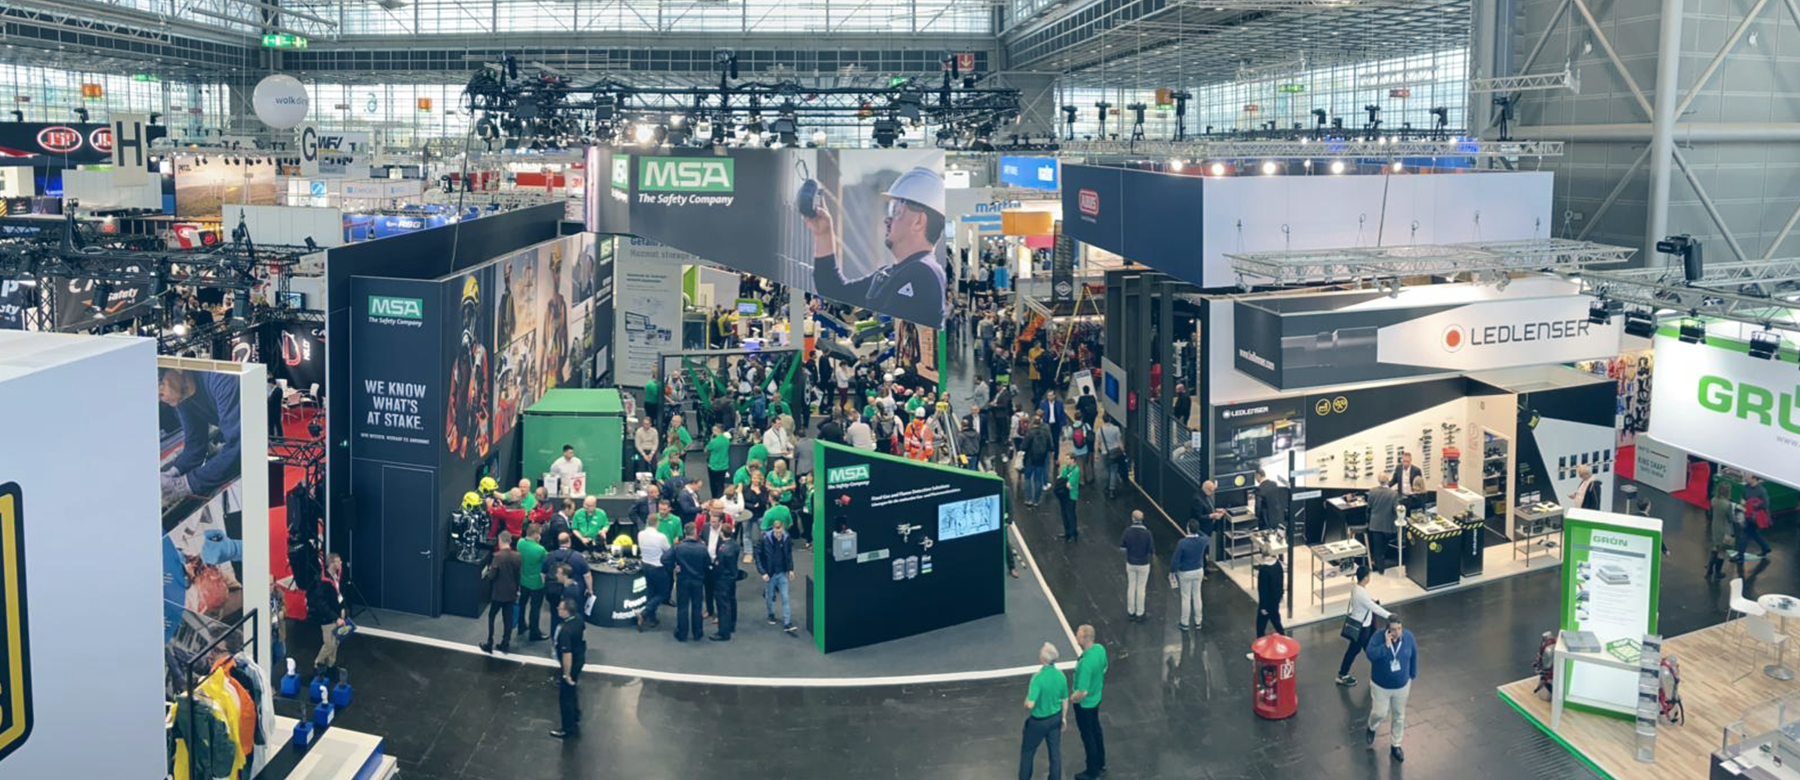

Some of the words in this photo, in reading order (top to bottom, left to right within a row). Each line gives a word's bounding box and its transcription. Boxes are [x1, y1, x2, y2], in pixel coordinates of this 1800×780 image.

[116, 121, 143, 167] H
[302, 126, 318, 162] G
[644, 161, 730, 188] MSA
[638, 193, 655, 204] The
[657, 193, 687, 206] Safety
[689, 194, 734, 206] Company
[371, 298, 421, 317] MSA
[368, 316, 379, 324] The
[379, 317, 397, 326] Safety
[397, 318, 423, 328] Company
[1470, 319, 1590, 346] LEDLENSER
[364, 379, 385, 395] WE
[388, 381, 427, 399] KNOW
[372, 395, 419, 414] WHAT'S
[1230, 405, 1269, 418] LEDLENSER
[366, 411, 381, 426] AT
[384, 413, 425, 430] STAKE.
[829, 465, 870, 483] MSA
[1593, 534, 1629, 547] GRÜN
